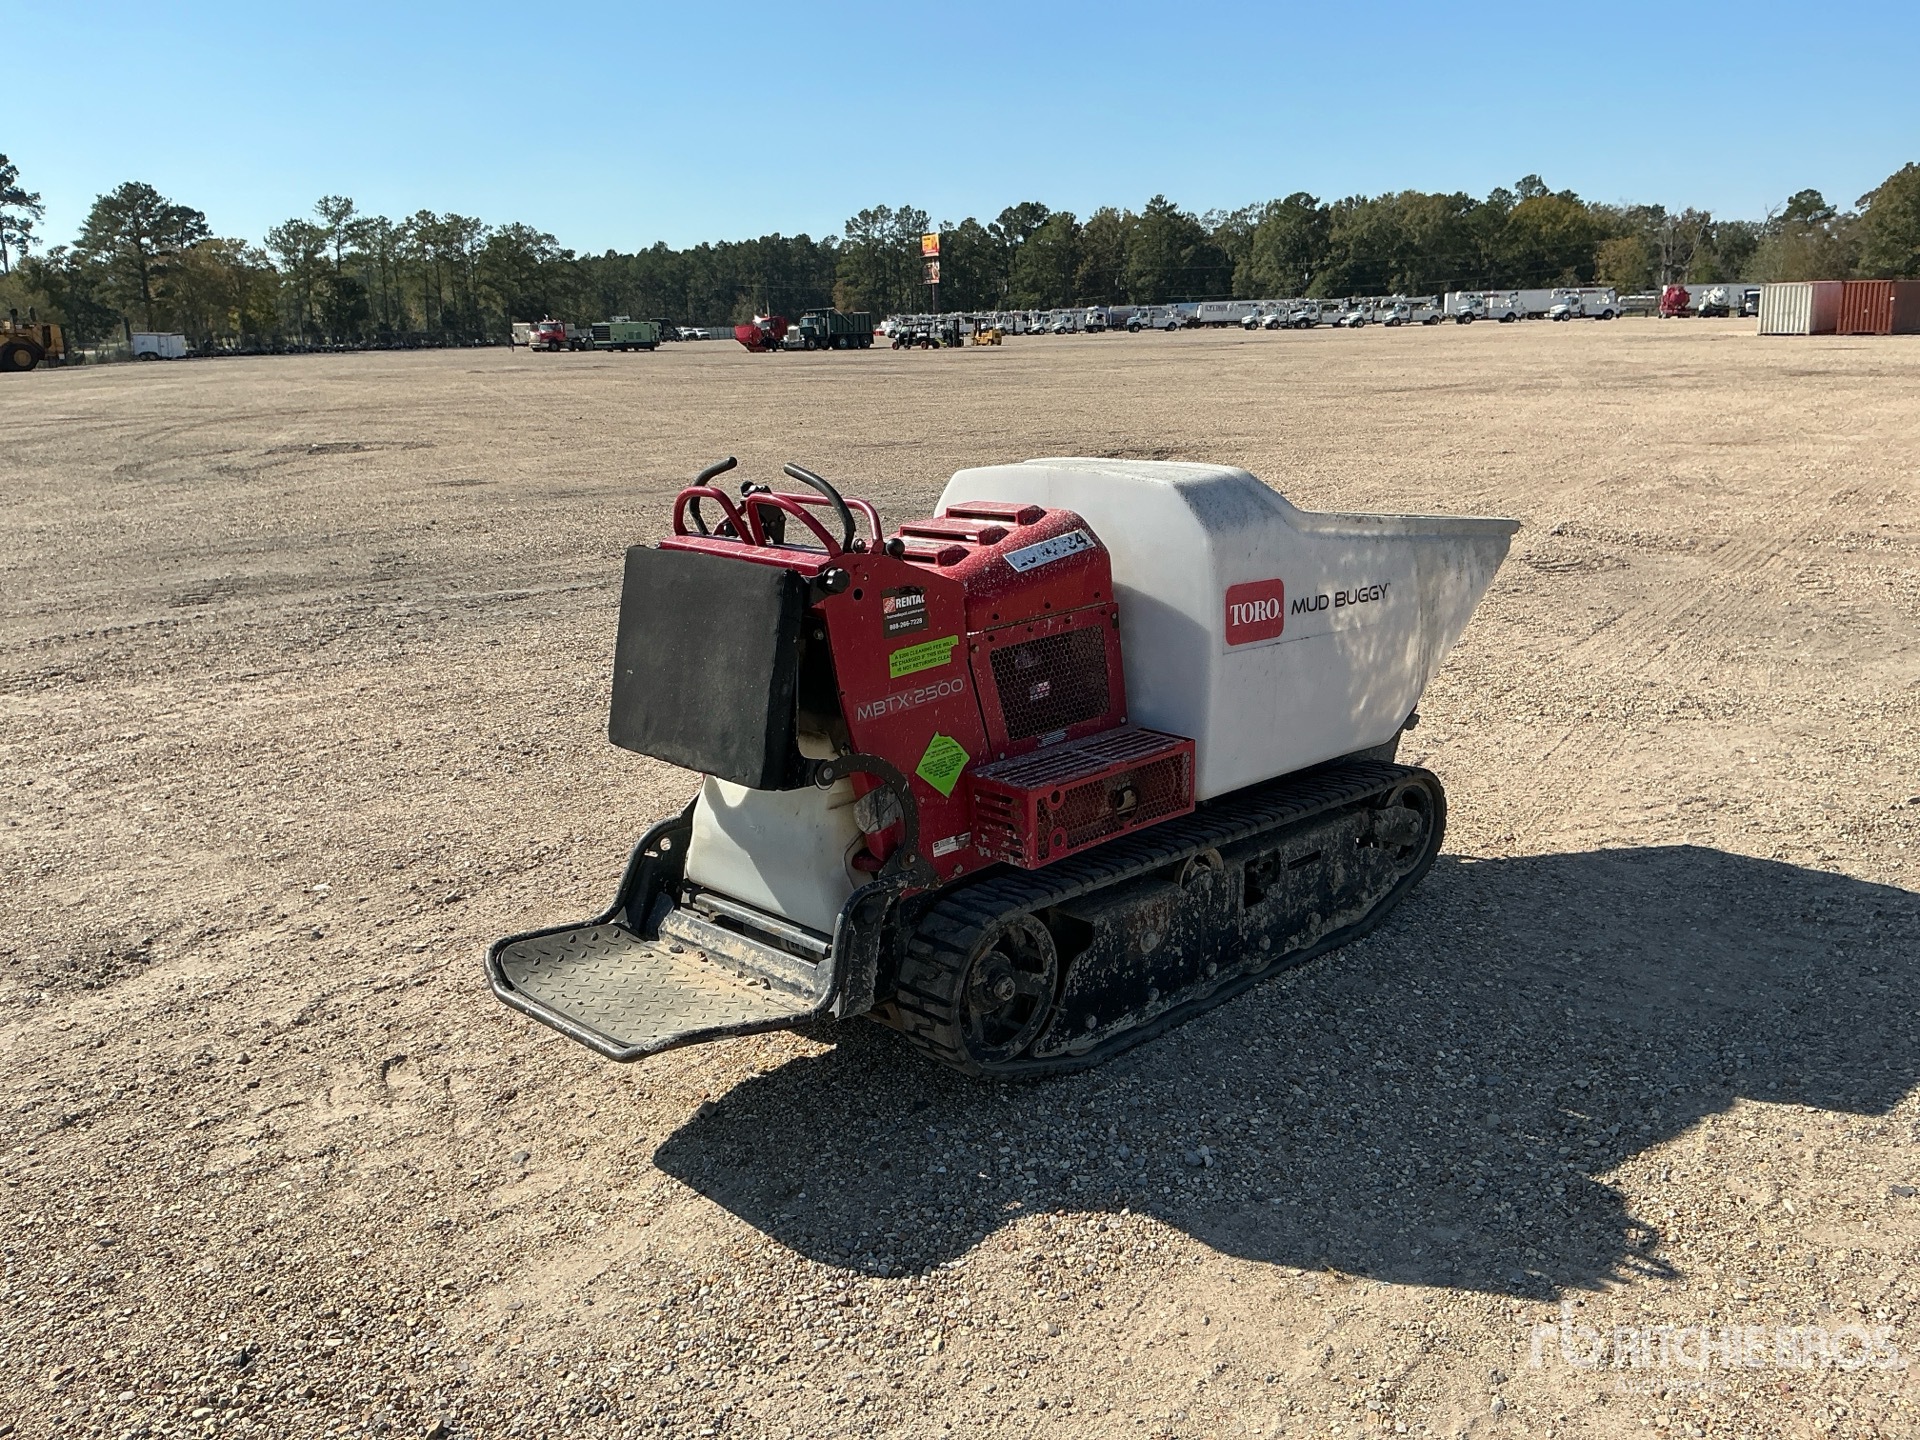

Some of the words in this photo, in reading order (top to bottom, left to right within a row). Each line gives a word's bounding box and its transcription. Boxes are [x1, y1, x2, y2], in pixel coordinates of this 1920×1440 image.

[895, 594, 925, 609] RENTAL
[1229, 598, 1280, 627] TORO
[1291, 594, 1330, 616] MUD
[1334, 584, 1387, 607] BUGGY
